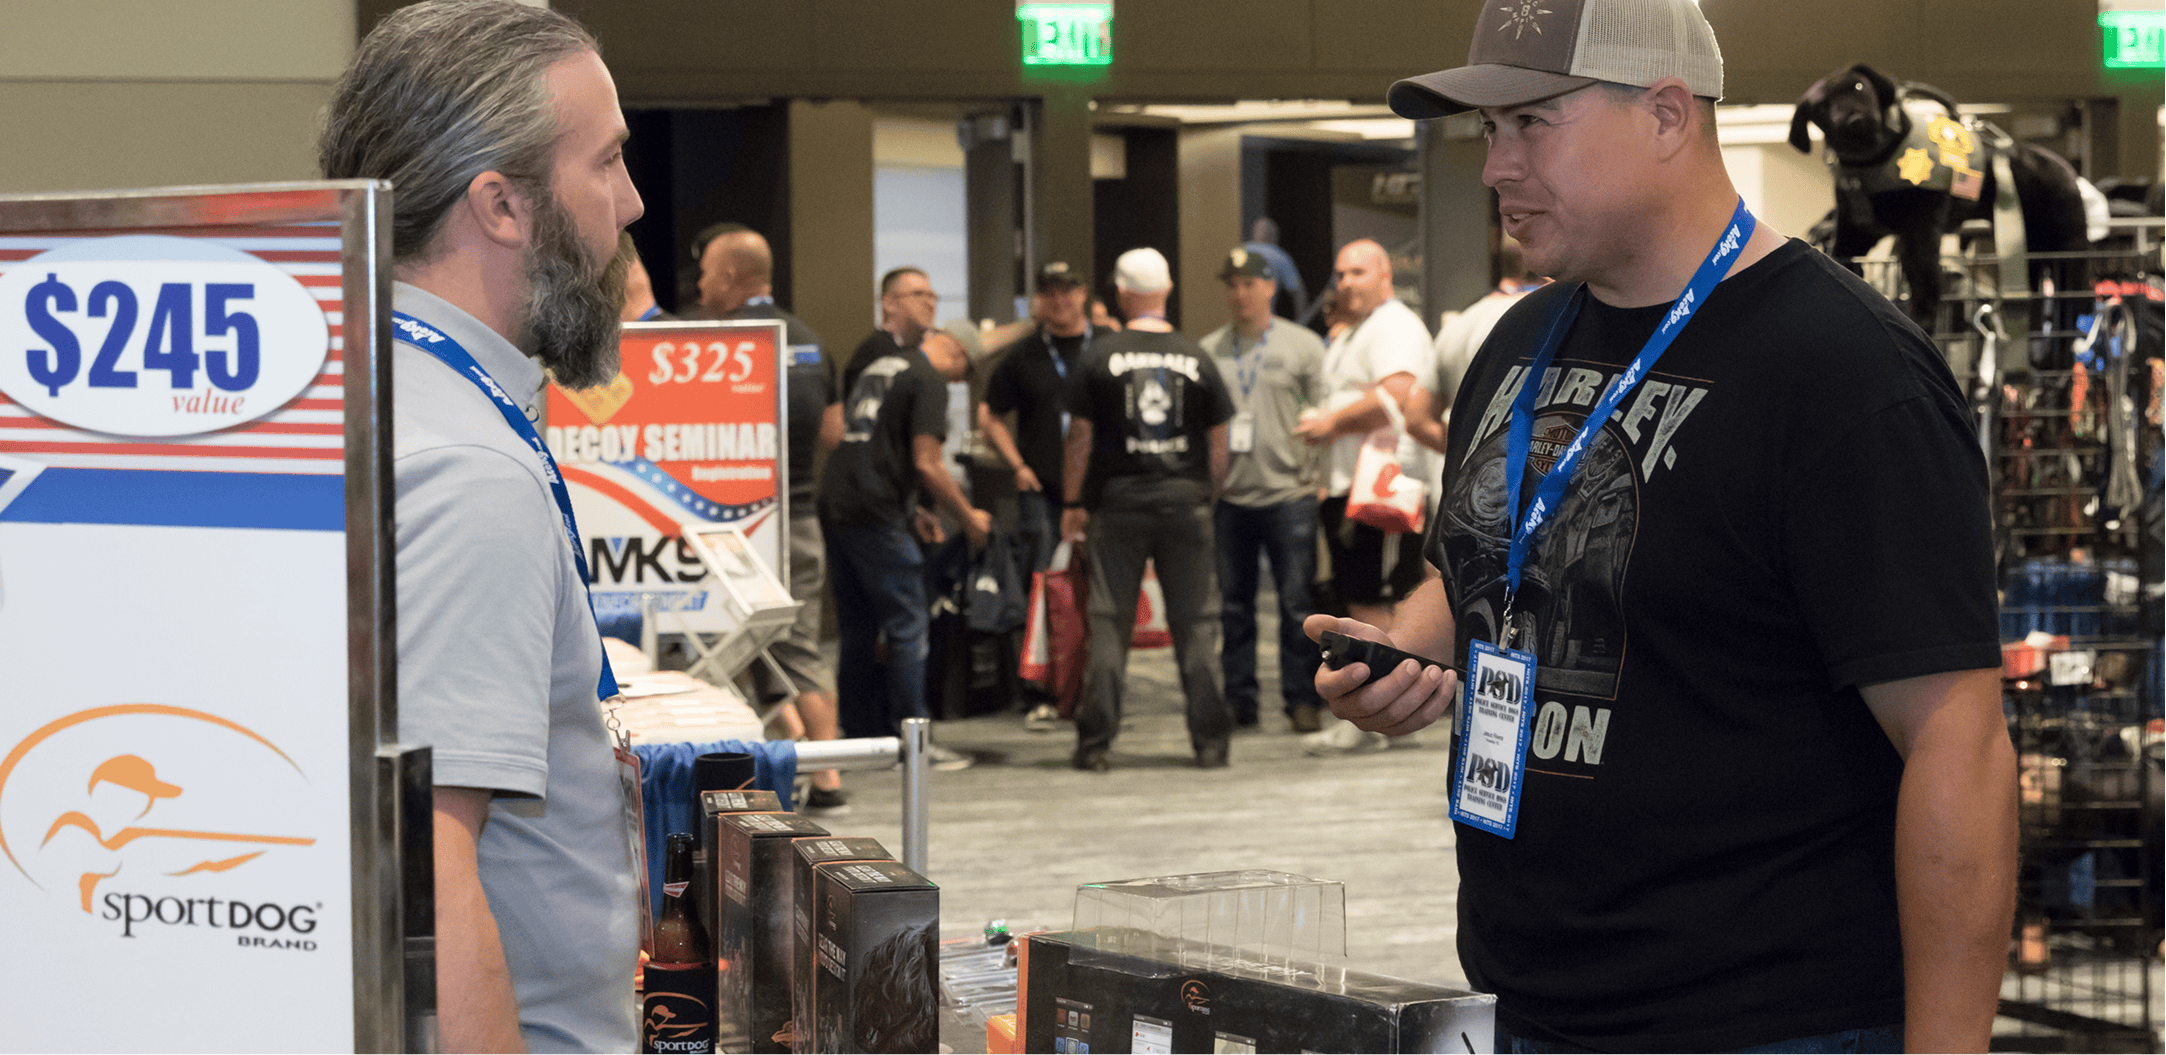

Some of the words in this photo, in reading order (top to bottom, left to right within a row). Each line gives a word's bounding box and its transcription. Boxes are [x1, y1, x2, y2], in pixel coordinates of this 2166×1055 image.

[2118, 24, 2164, 62] EXI
[25, 273, 260, 397] $245
[649, 341, 755, 385] $325
[172, 388, 245, 415] value
[547, 424, 640, 464] DECOY
[644, 422, 777, 462] SEMINAR
[102, 893, 317, 937] sportDOG
[238, 936, 317, 951] BRAND
[653, 1040, 709, 1054] sportDOG
